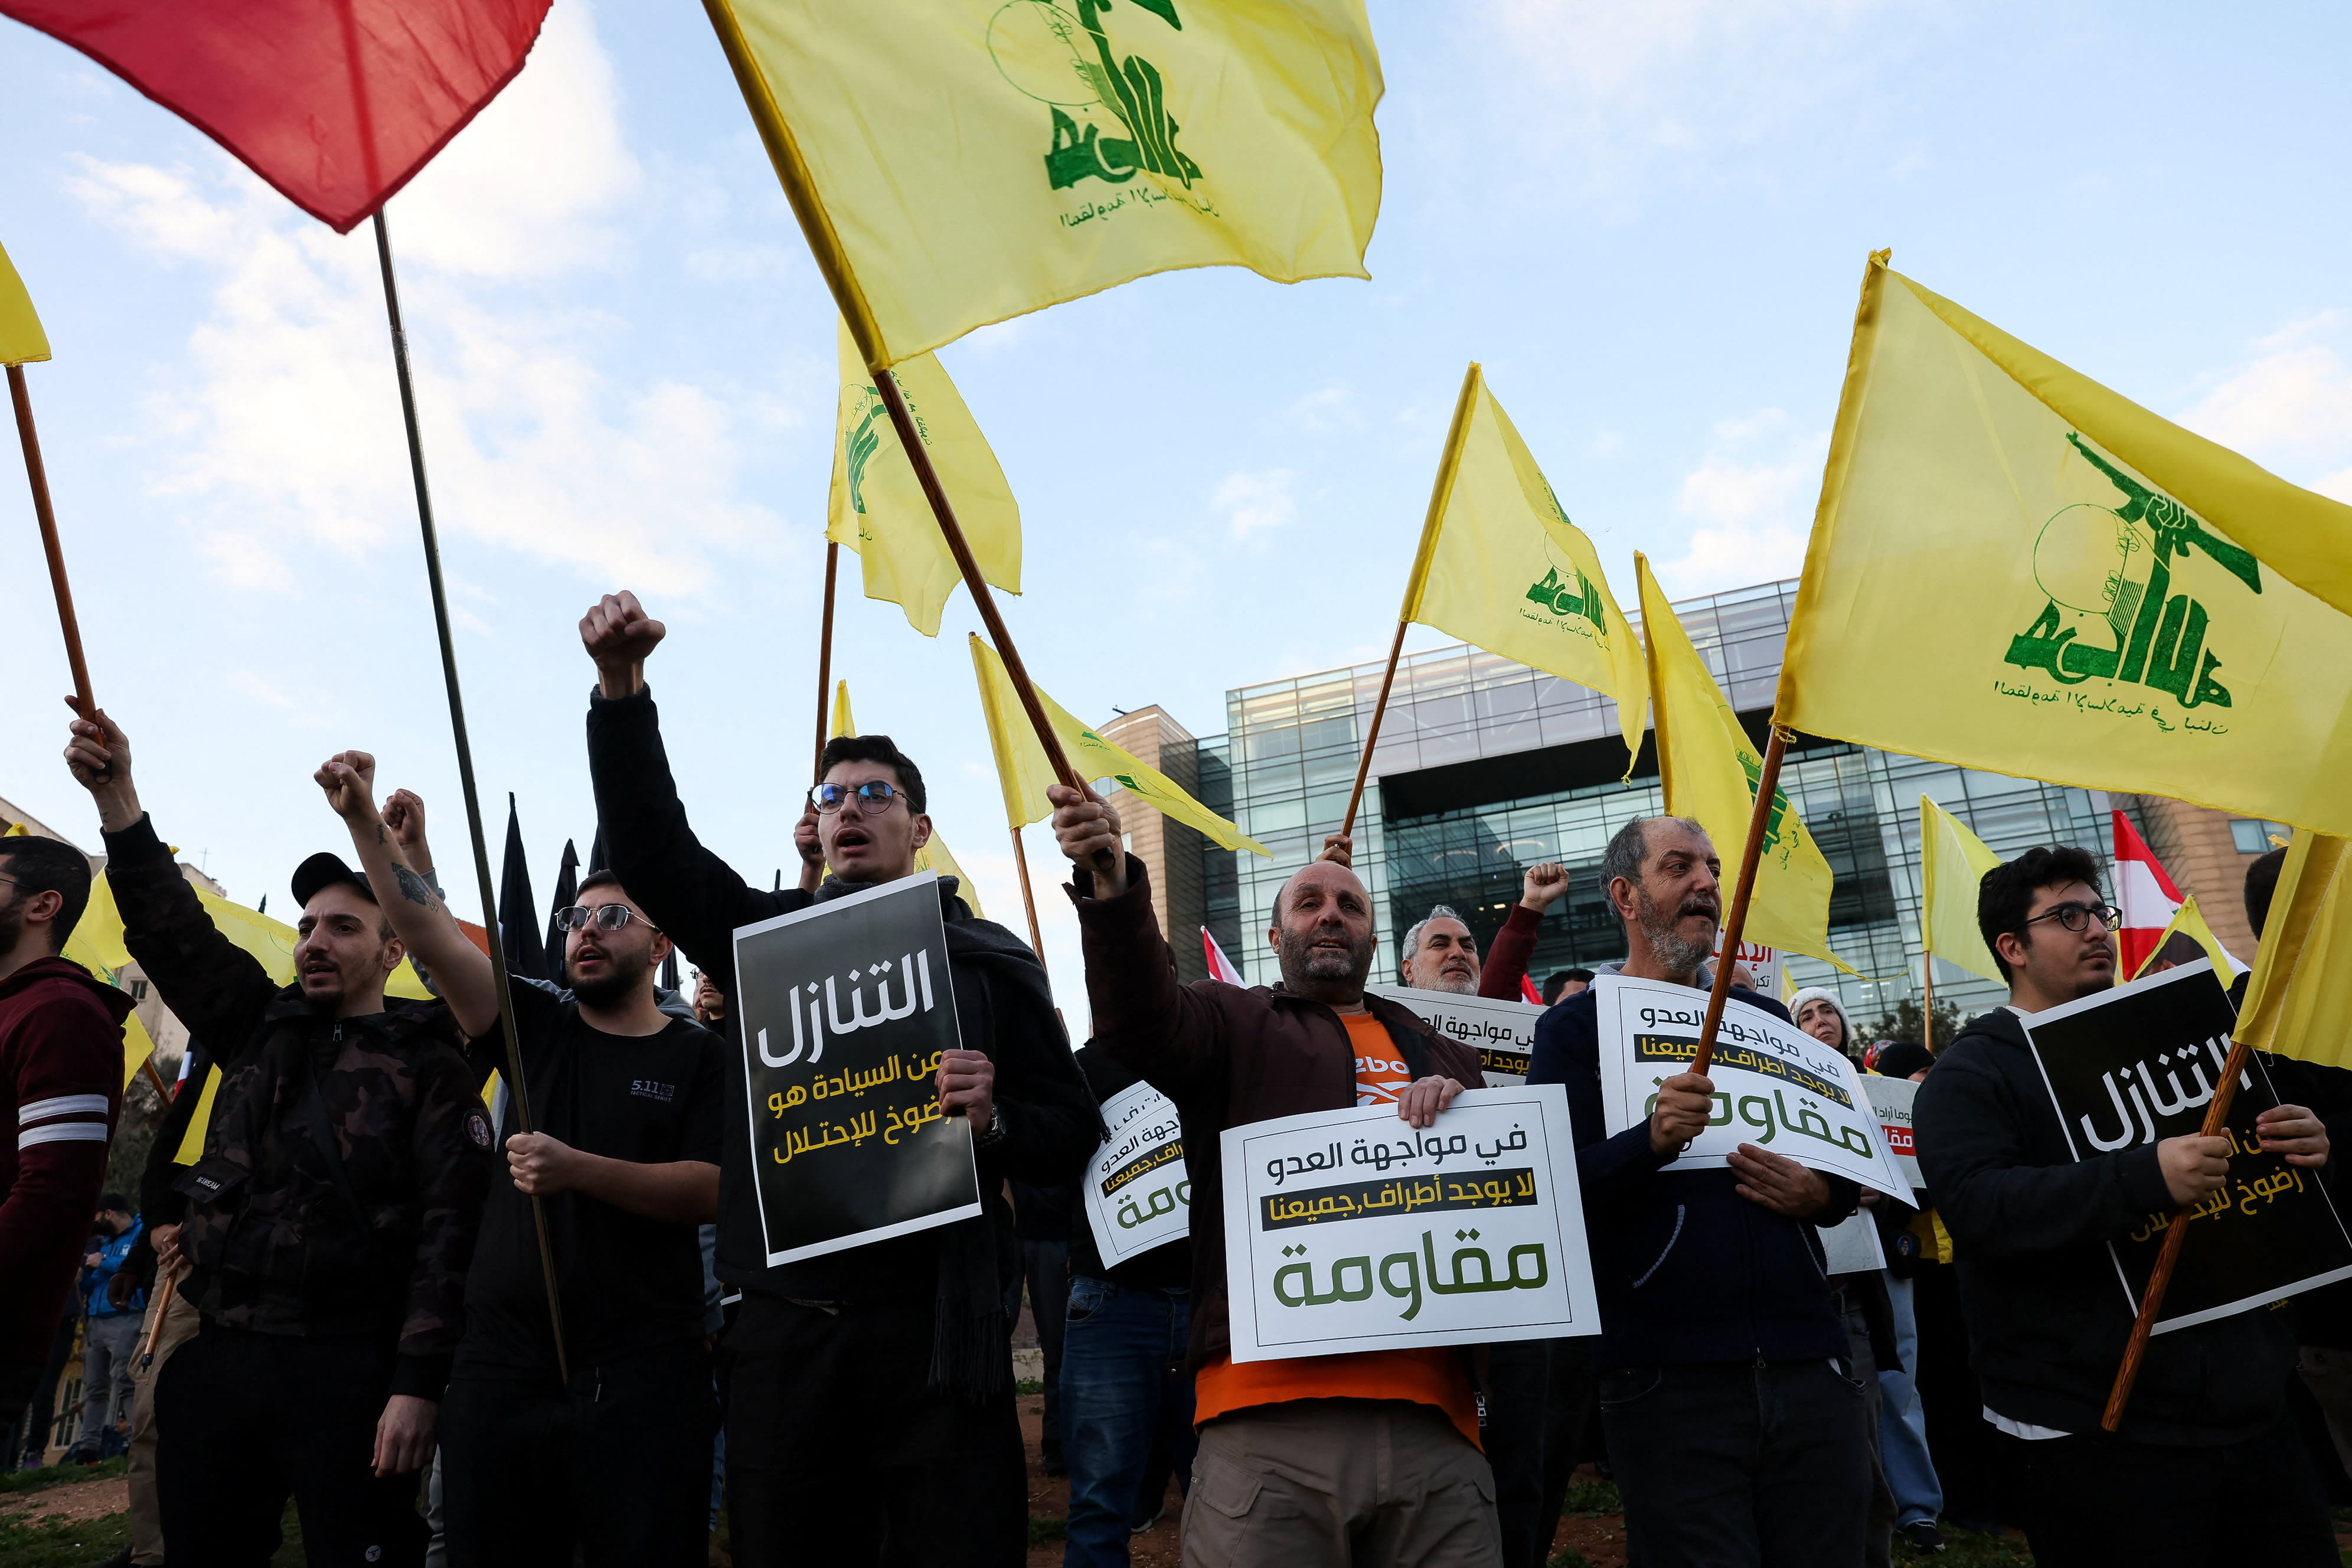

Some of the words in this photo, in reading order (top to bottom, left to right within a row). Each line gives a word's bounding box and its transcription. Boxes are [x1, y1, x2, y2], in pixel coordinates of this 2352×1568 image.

[758, 948, 934, 1067] التنازل
[1446, 1016, 1512, 1044] مواجهة
[813, 1054, 901, 1100] السيادة
[907, 1050, 942, 1081] عن
[1805, 1057, 1840, 1079] في
[630, 1090, 653, 1099] TACTICAL
[631, 1080, 659, 1094] 5.11
[1790, 1069, 1837, 1102] يوجد
[767, 1086, 807, 1119] هو
[1100, 1135, 1141, 1174] العدو
[1351, 1131, 1467, 1171] مواجهة
[1475, 1123, 1527, 1166] في
[1267, 1141, 1343, 1186] العدو
[1448, 1180, 1512, 1206] يوجد
[1517, 1171, 1534, 1196] لا
[2237, 1165, 2304, 1216] رضوخ
[1273, 1228, 1549, 1322] مقاومة
